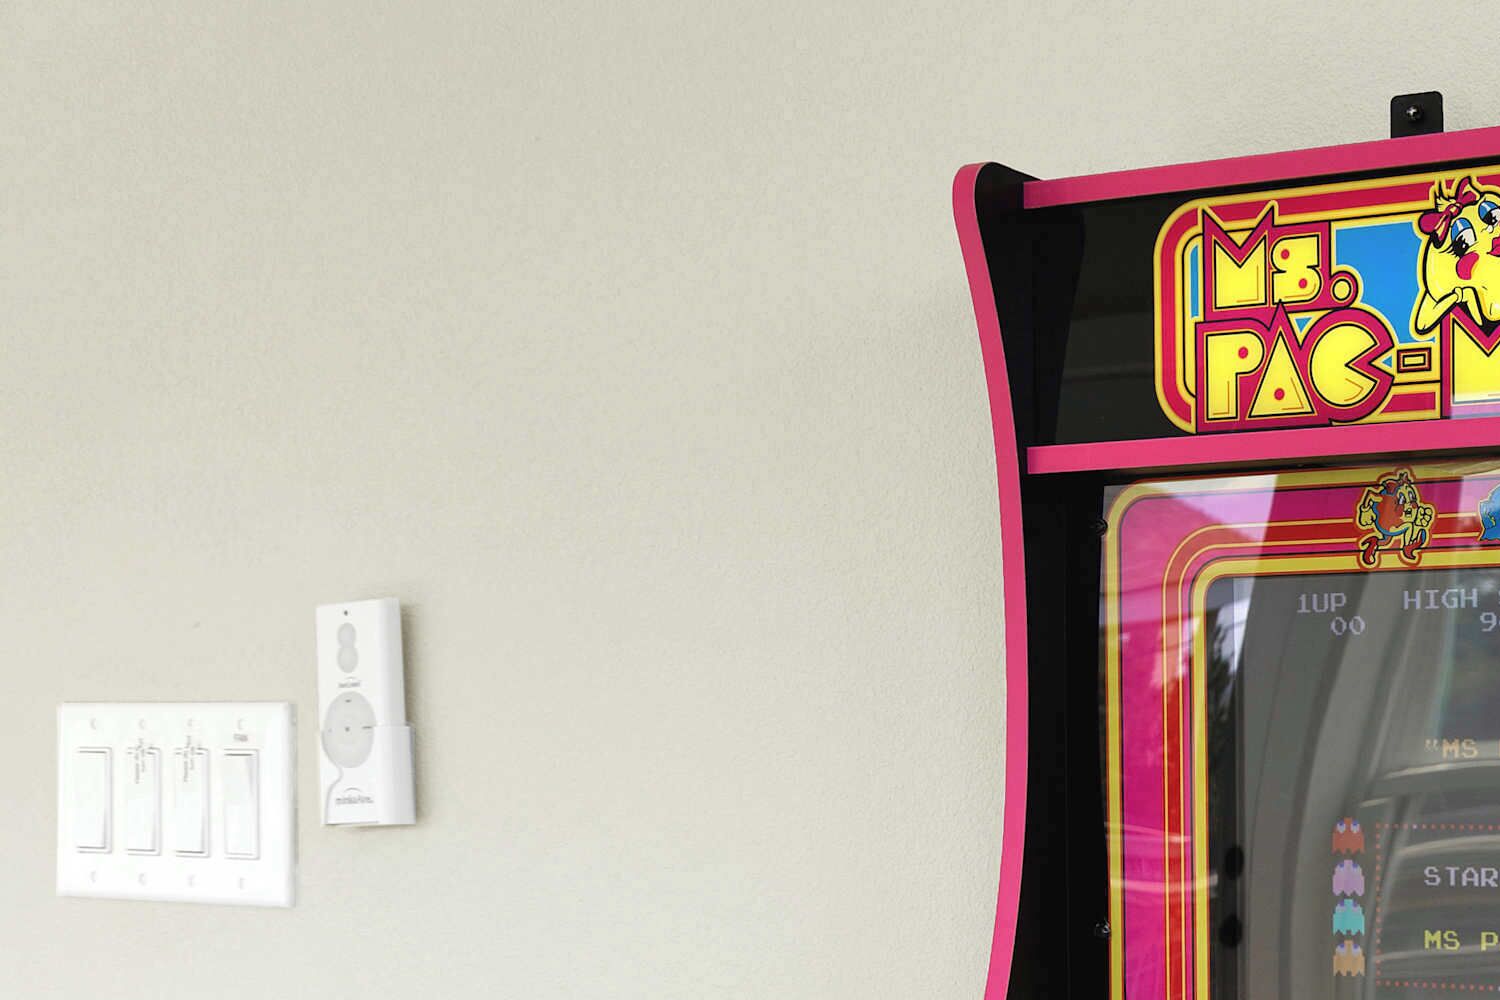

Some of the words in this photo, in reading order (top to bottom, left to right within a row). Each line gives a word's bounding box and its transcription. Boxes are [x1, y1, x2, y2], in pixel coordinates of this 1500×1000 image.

[1204, 211, 1357, 313] MS.
[1297, 592, 1347, 614] 1UP
[1403, 588, 1478, 610] HIGH
[1330, 615, 1366, 636] 00
[1424, 930, 1460, 951] MS
